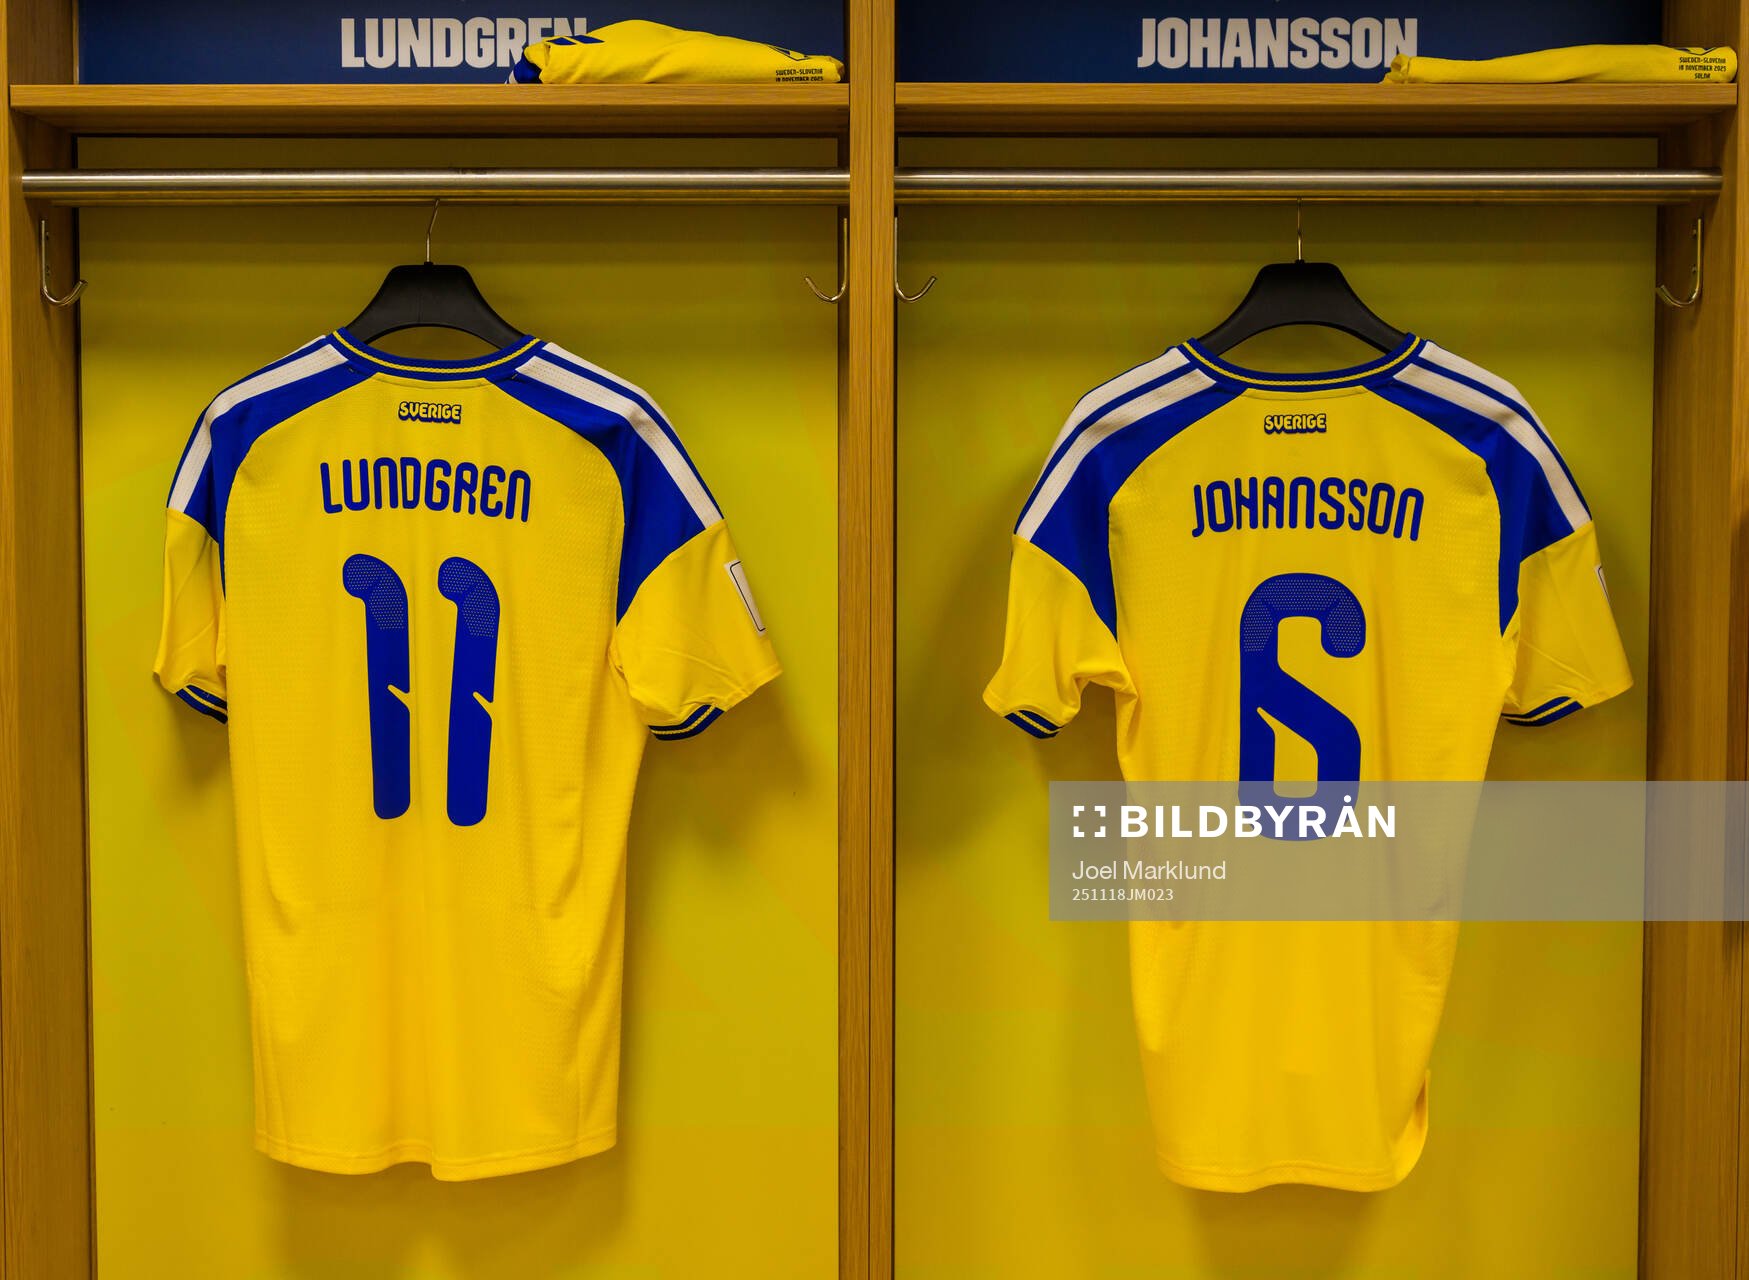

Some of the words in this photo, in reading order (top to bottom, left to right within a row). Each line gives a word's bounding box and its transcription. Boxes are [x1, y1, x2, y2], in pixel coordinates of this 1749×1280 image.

[1137, 17, 1418, 69] JOHANSSON
[398, 401, 462, 425] SVERIGE
[1264, 413, 1327, 435] SVERIGE
[320, 457, 531, 523] LUNDGREN
[1192, 476, 1424, 542] JOHANSSON
[342, 553, 500, 827] 11
[1238, 572, 1366, 842] 6
